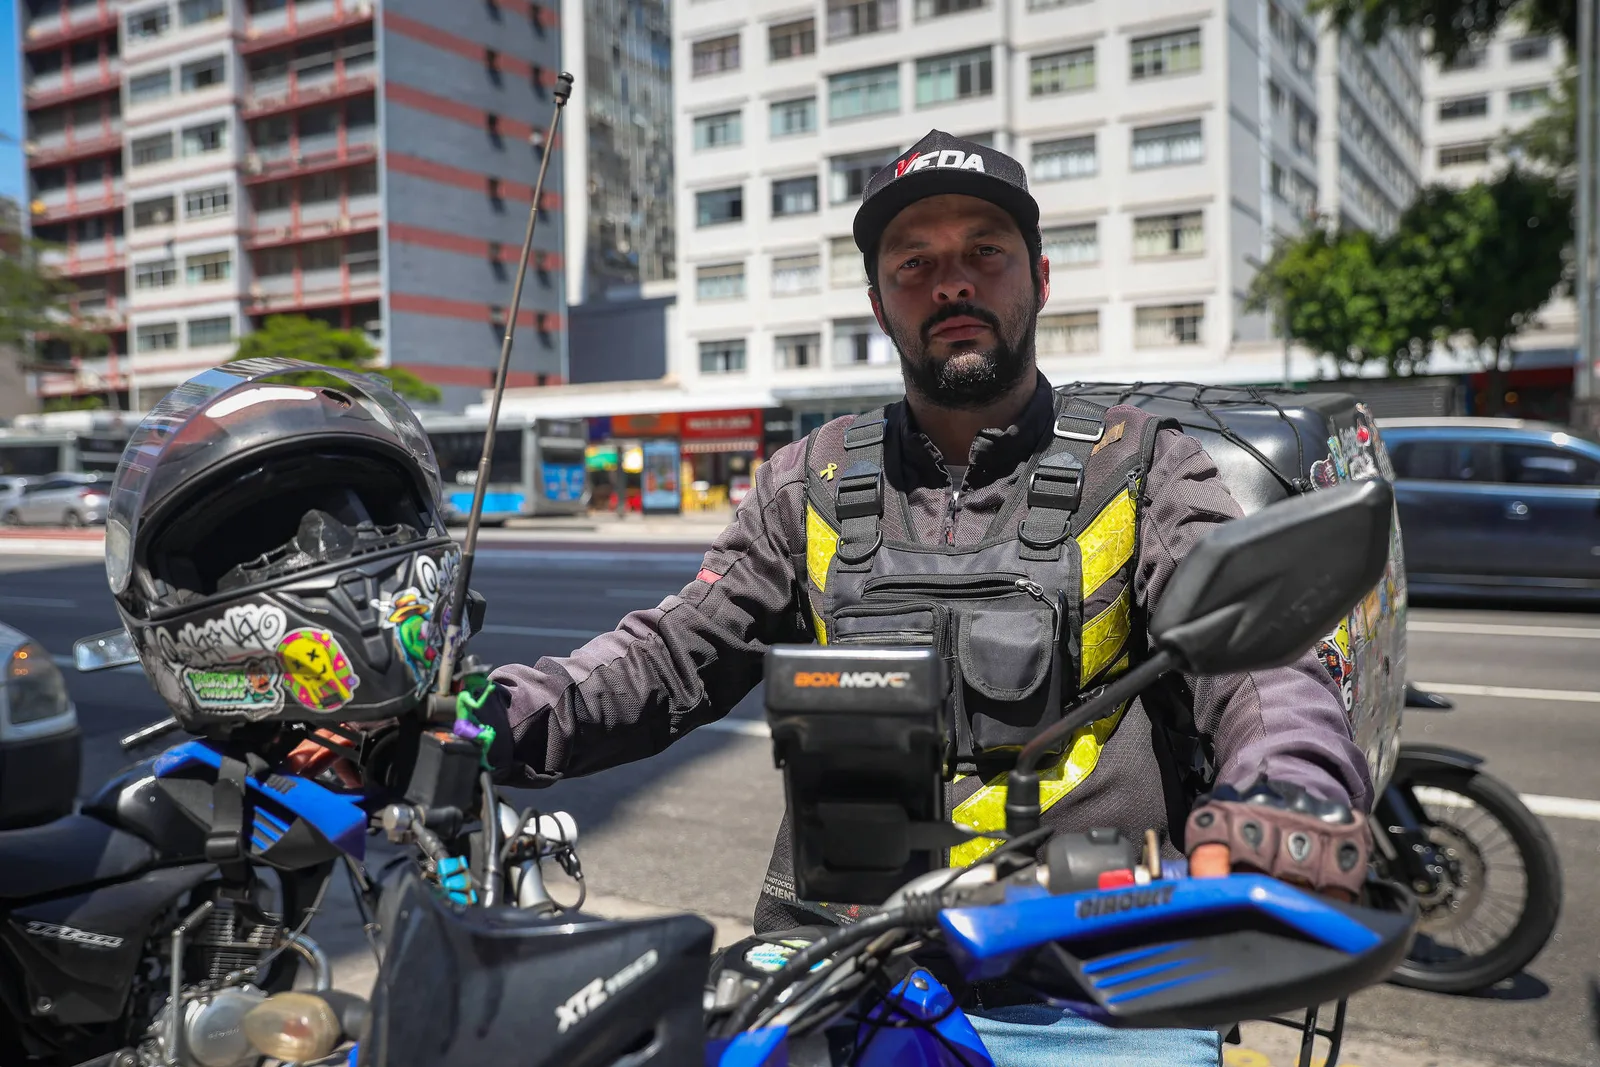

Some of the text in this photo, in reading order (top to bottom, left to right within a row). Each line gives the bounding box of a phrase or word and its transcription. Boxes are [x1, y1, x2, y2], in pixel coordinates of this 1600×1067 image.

[895, 150, 985, 178] VEDA
[794, 671, 911, 688] BOXMOVE
[555, 977, 607, 1034] XTZ
